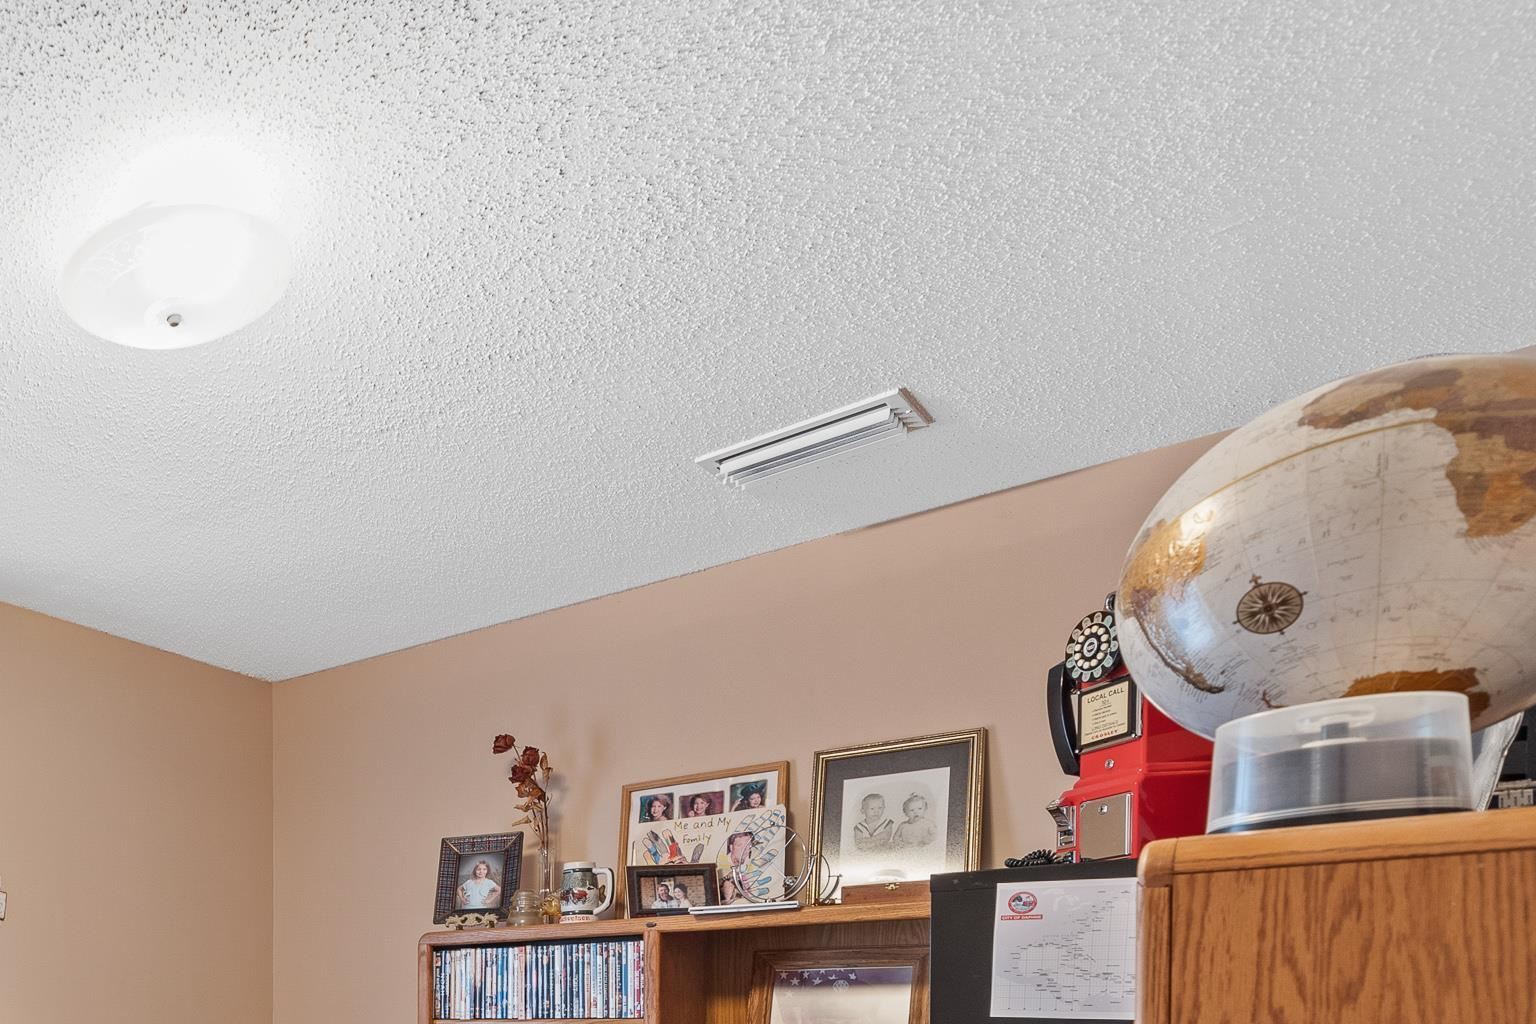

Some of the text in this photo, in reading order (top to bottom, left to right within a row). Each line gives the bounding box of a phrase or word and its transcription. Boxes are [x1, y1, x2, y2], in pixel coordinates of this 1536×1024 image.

[1088, 688, 1124, 703] LOCAL CALL
[1091, 730, 1117, 739] CROSLEY
[674, 817, 731, 831] Me and My
[683, 834, 712, 845] Family
